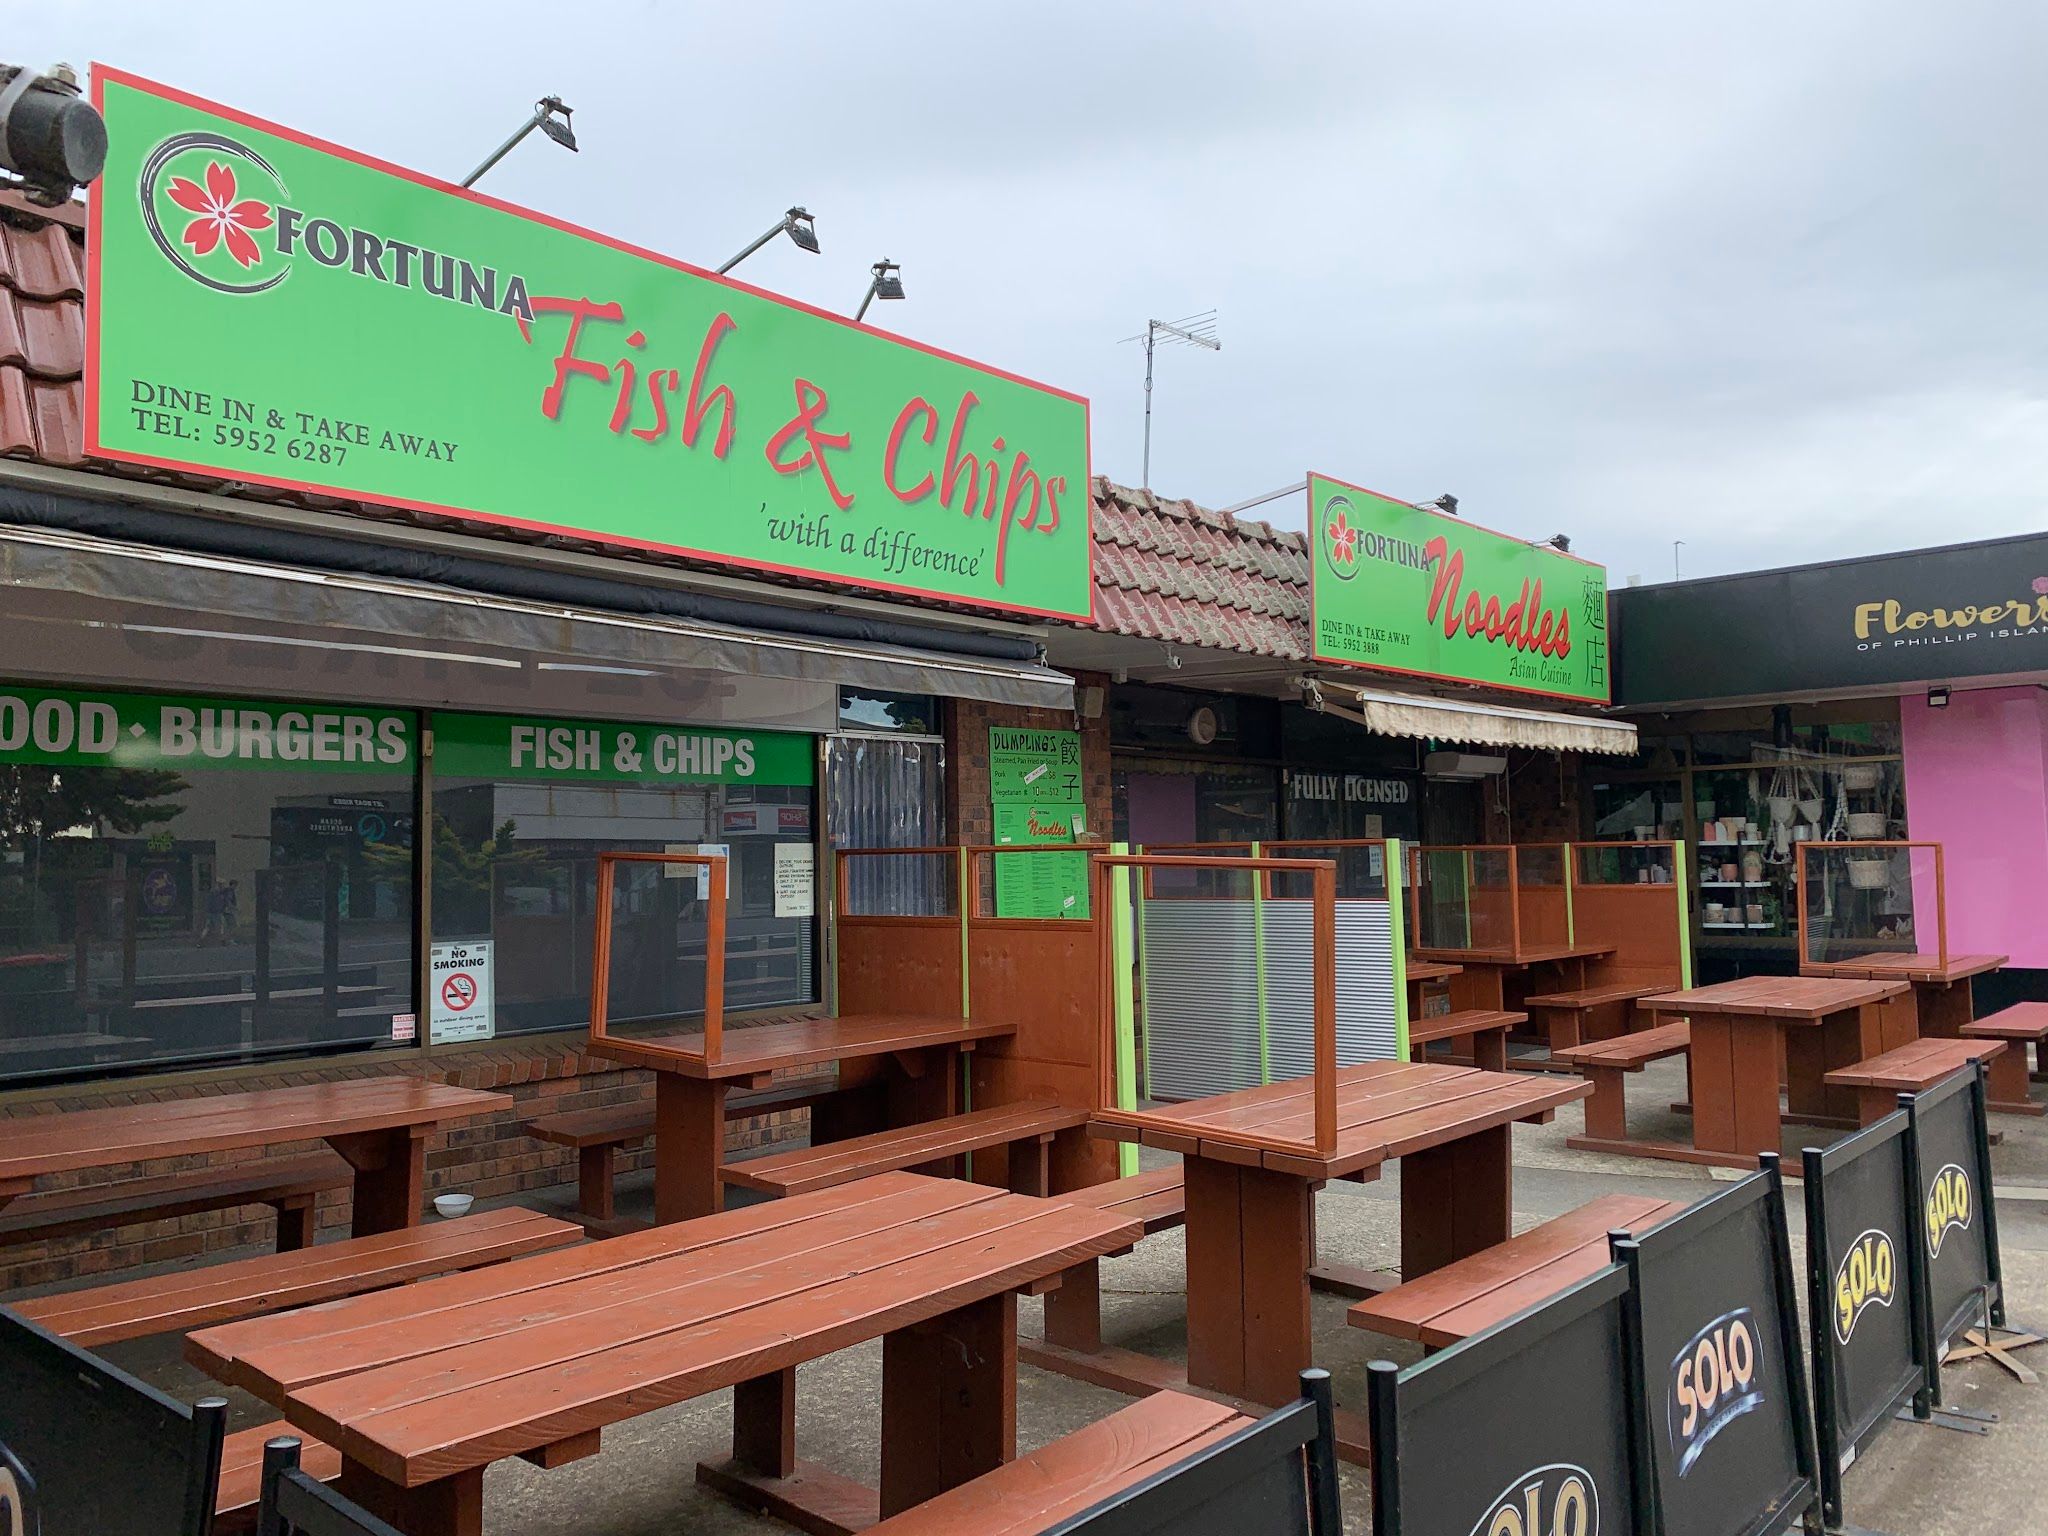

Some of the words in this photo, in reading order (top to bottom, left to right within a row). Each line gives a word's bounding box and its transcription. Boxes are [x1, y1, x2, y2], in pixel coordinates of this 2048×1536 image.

[275, 205, 535, 322] FORTUNA
[131, 380, 211, 415] DINE
[222, 398, 255, 424] IN
[266, 409, 285, 430] &
[296, 412, 370, 446] TAKE
[379, 431, 458, 463] AWAY
[131, 407, 200, 441] TEL:
[213, 424, 276, 455] 5952
[287, 439, 347, 467] 6287
[516, 298, 737, 461] Fish
[766, 378, 855, 511] &
[883, 390, 1067, 587] Chips
[840, 532, 857, 553] a
[1357, 529, 1430, 572] FORTUNA
[1425, 536, 1571, 660] Noodles
[1322, 619, 1342, 634] DINE
[1345, 623, 1354, 636] IN
[1357, 626, 1363, 637] &
[1365, 627, 1386, 642] TAKE
[1387, 631, 1410, 646] AWAY
[1322, 634, 1341, 648] TEL:
[1343, 637, 1361, 652] 5952
[1857, 641, 1882, 651] OF
[1895, 632, 1978, 647] PHILLIP
[1510, 656, 1537, 680] Asian
[1540, 660, 1572, 685] Cuisine
[160, 706, 408, 764] BURGERS
[511, 725, 600, 771] FISH
[613, 731, 643, 773] &
[653, 734, 756, 777] CHIPS
[994, 732, 1057, 752] DUMPLINGS
[994, 770, 1006, 778] Pork
[1060, 738, 1080, 800] 餃子
[1294, 774, 1338, 800] FULLY
[1344, 774, 1409, 803] LICENSED
[1027, 817, 1067, 837] Noodles
[433, 958, 485, 970] SMOKING
[451, 949, 467, 959] NO
[1929, 1171, 1968, 1249] SOLO
[1838, 1238, 1892, 1335] SOLO
[1677, 1320, 1754, 1437] SOLO
